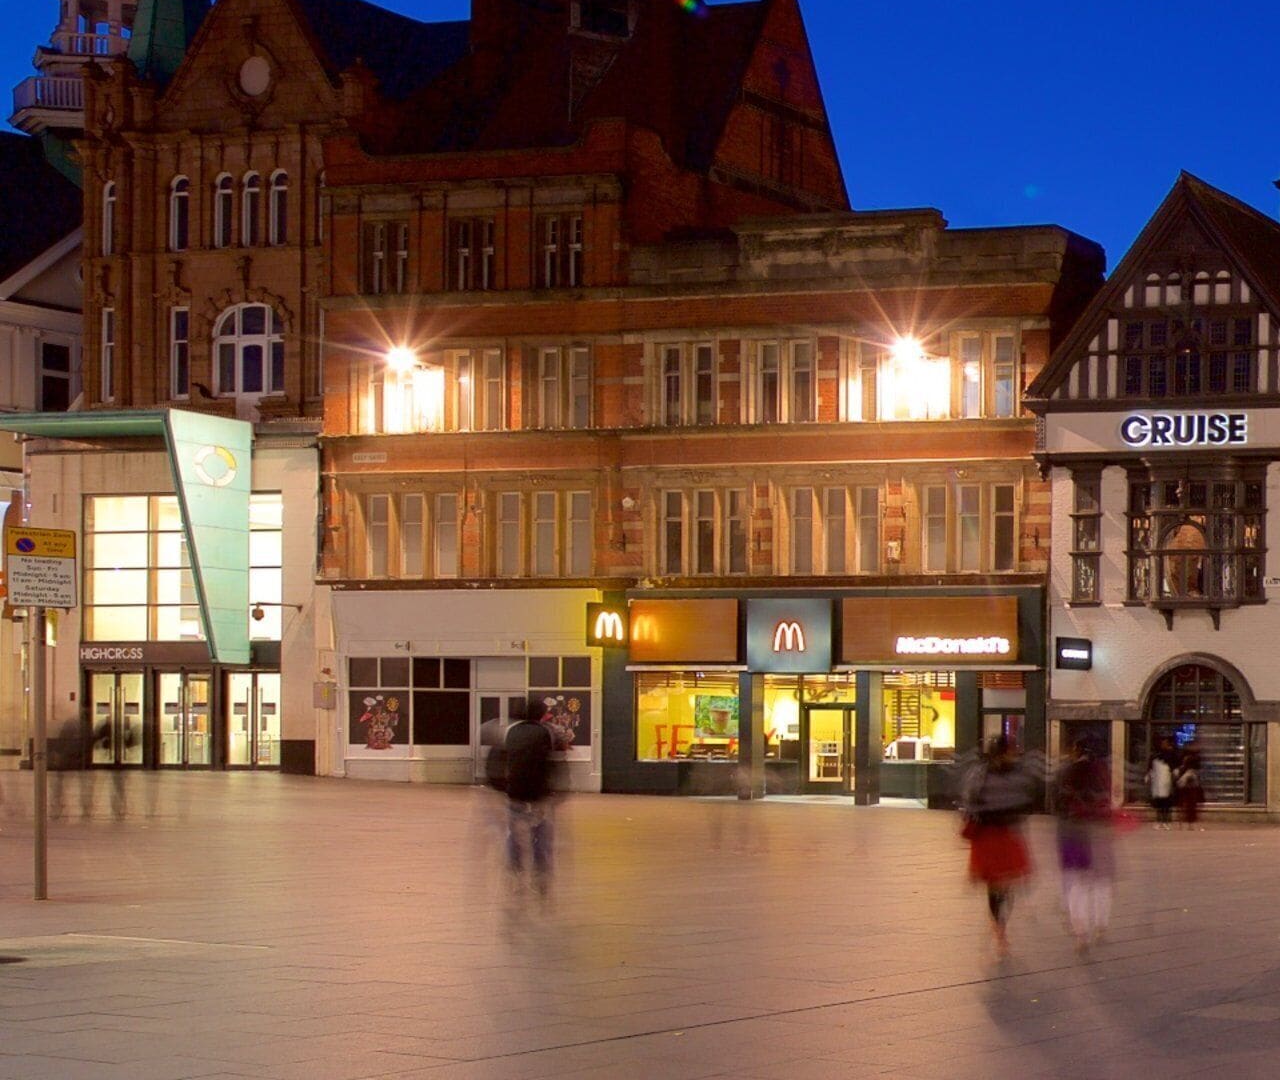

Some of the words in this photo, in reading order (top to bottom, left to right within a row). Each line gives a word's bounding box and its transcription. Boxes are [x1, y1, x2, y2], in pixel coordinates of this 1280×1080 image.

[1121, 413, 1247, 446] CRUISE
[81, 648, 144, 659] HIGHCROSS
[896, 636, 1010, 654] McDonald's
